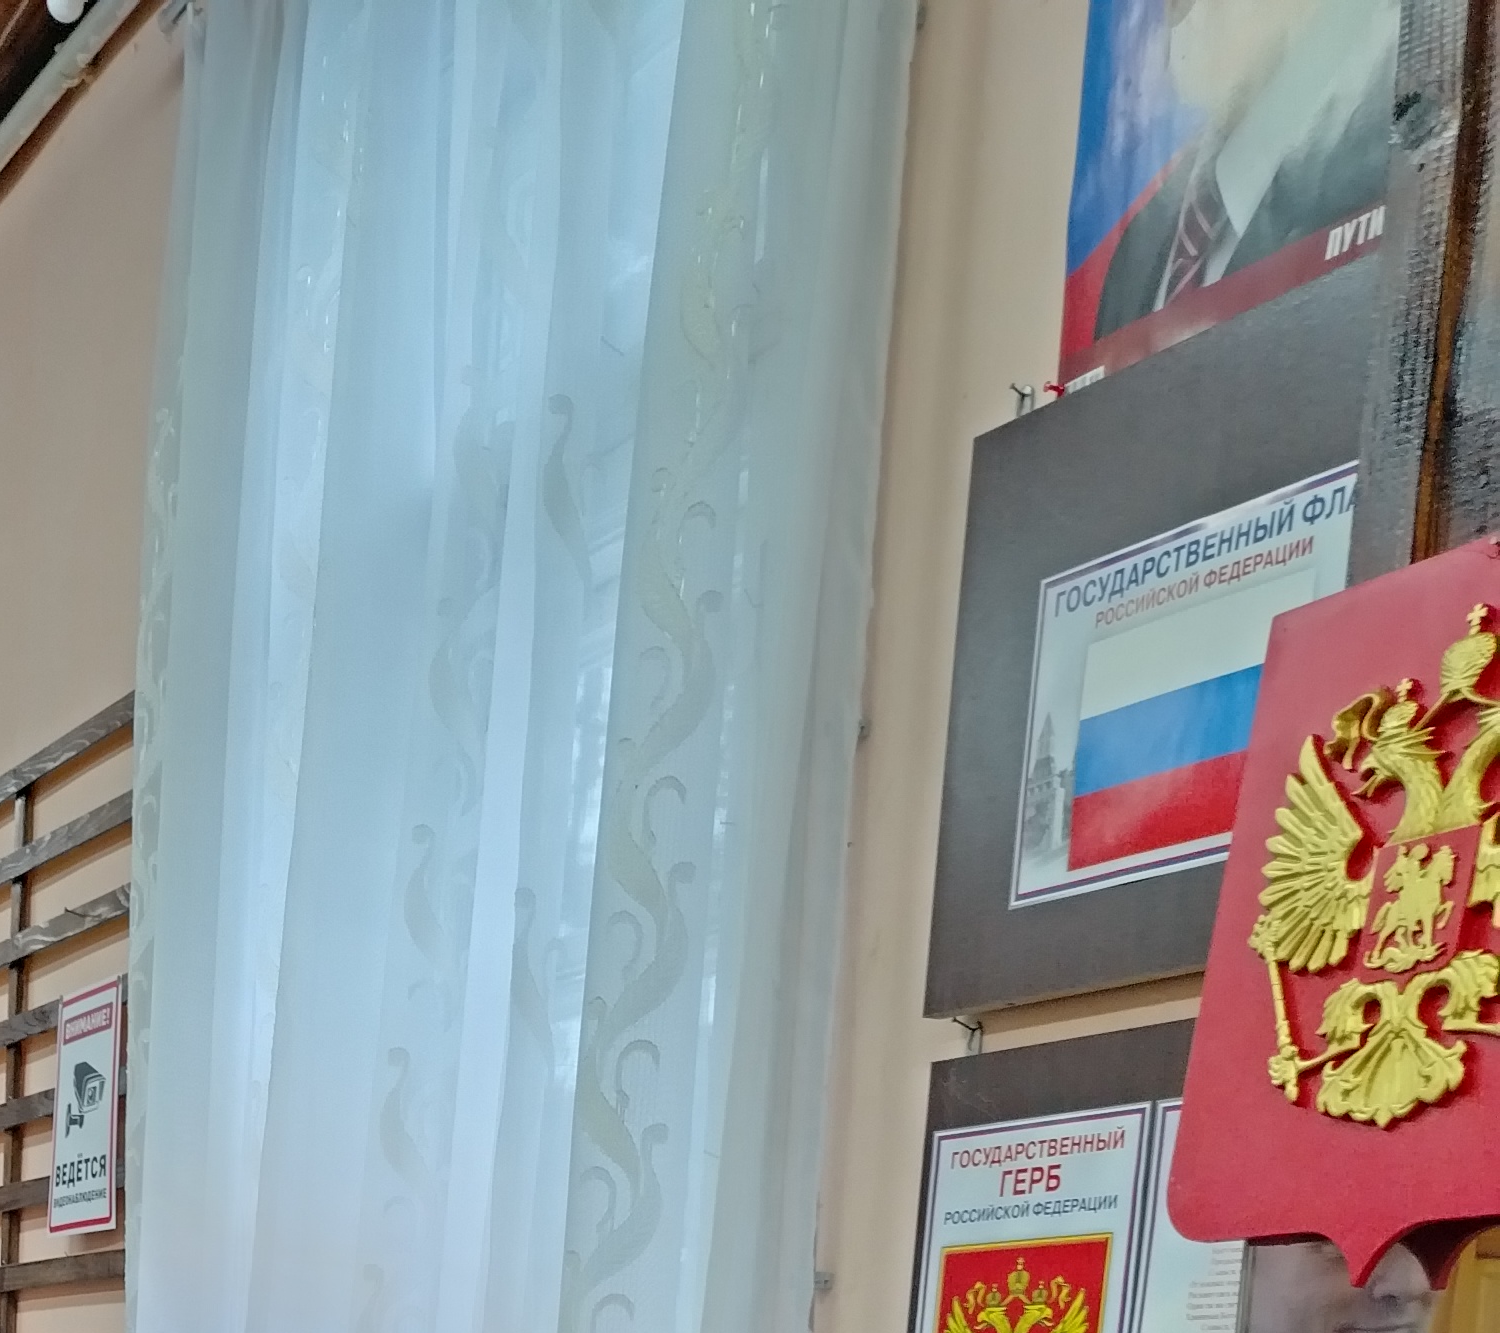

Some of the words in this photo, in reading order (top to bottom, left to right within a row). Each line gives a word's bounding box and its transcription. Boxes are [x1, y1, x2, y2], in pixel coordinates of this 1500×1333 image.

[1054, 498, 1296, 618] ГОСУДАРСТВЕННЫЙ
[1095, 571, 1200, 629] РОССИЙСКОЙ
[1203, 536, 1315, 592] ФЕДЕРАЦИИ
[950, 1127, 1126, 1170] ГОСУДАРСТВЕННЫЙ
[55, 1154, 107, 1189] ВЕДЁТСЯ
[998, 1164, 1063, 1198] ГЕРБ
[943, 1201, 1031, 1226] РОССИЙСКОЙ
[1032, 1194, 1119, 1218] ФЕДЕРАЦИИ
